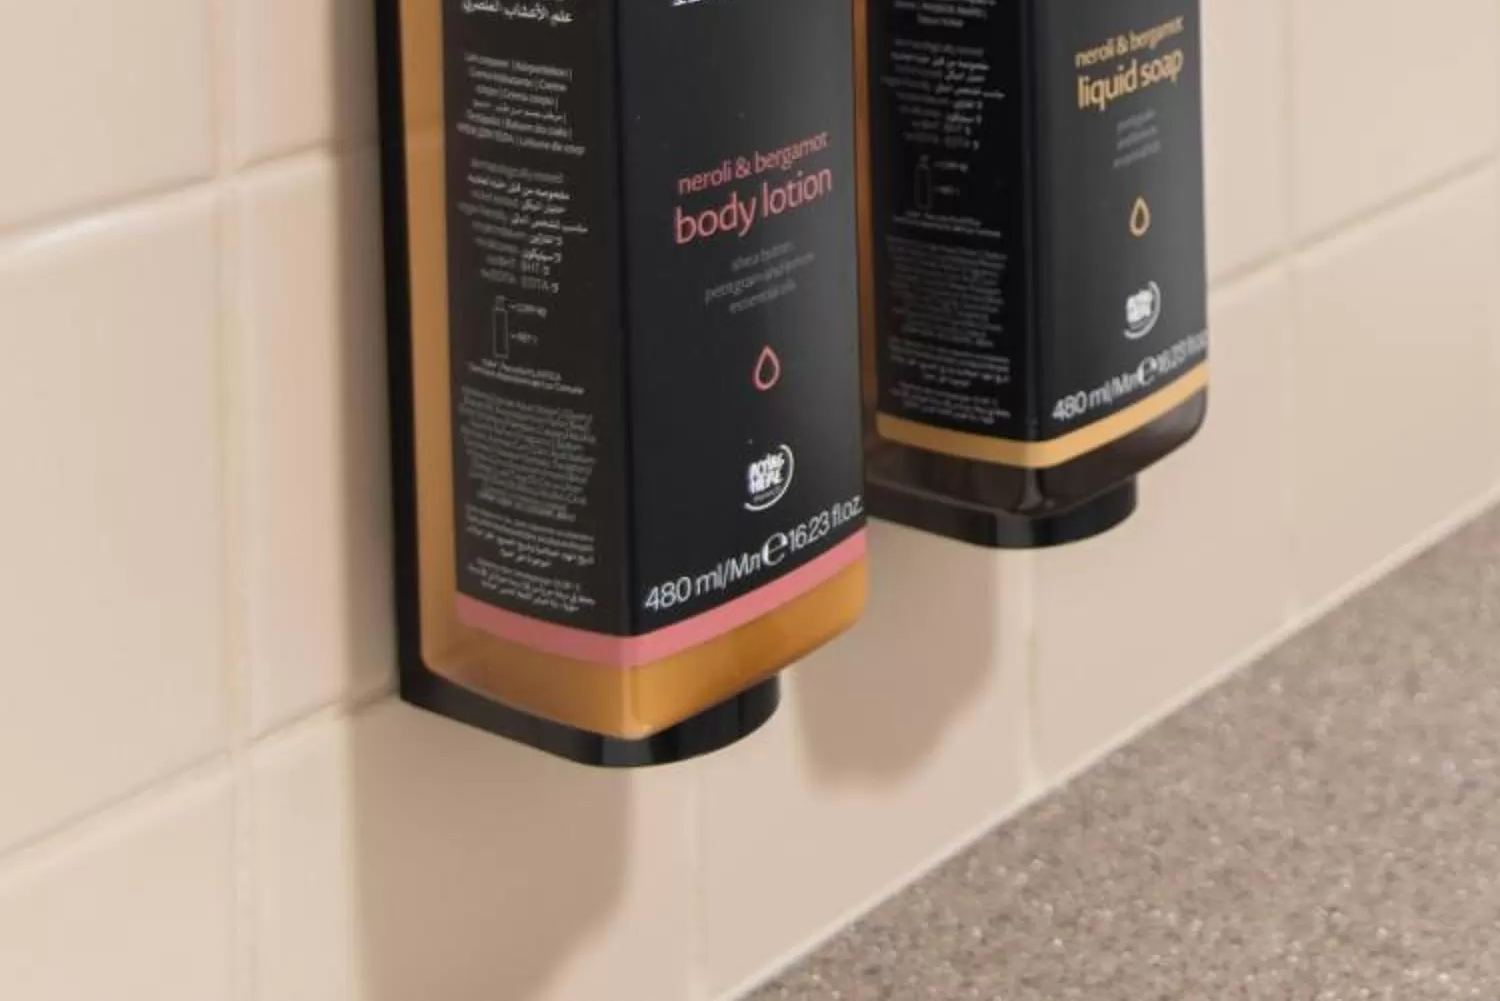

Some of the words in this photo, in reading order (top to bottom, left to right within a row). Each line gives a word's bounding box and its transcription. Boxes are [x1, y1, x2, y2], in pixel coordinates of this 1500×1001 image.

[1077, 58, 1139, 112] liquid
[1140, 48, 1185, 87] soap
[678, 160, 732, 195] neroli
[734, 156, 751, 179] &
[754, 131, 829, 171] bergamot
[675, 190, 757, 244] body
[762, 168, 833, 218] lotion
[1052, 390, 1087, 420] 480
[643, 576, 692, 612] 480
